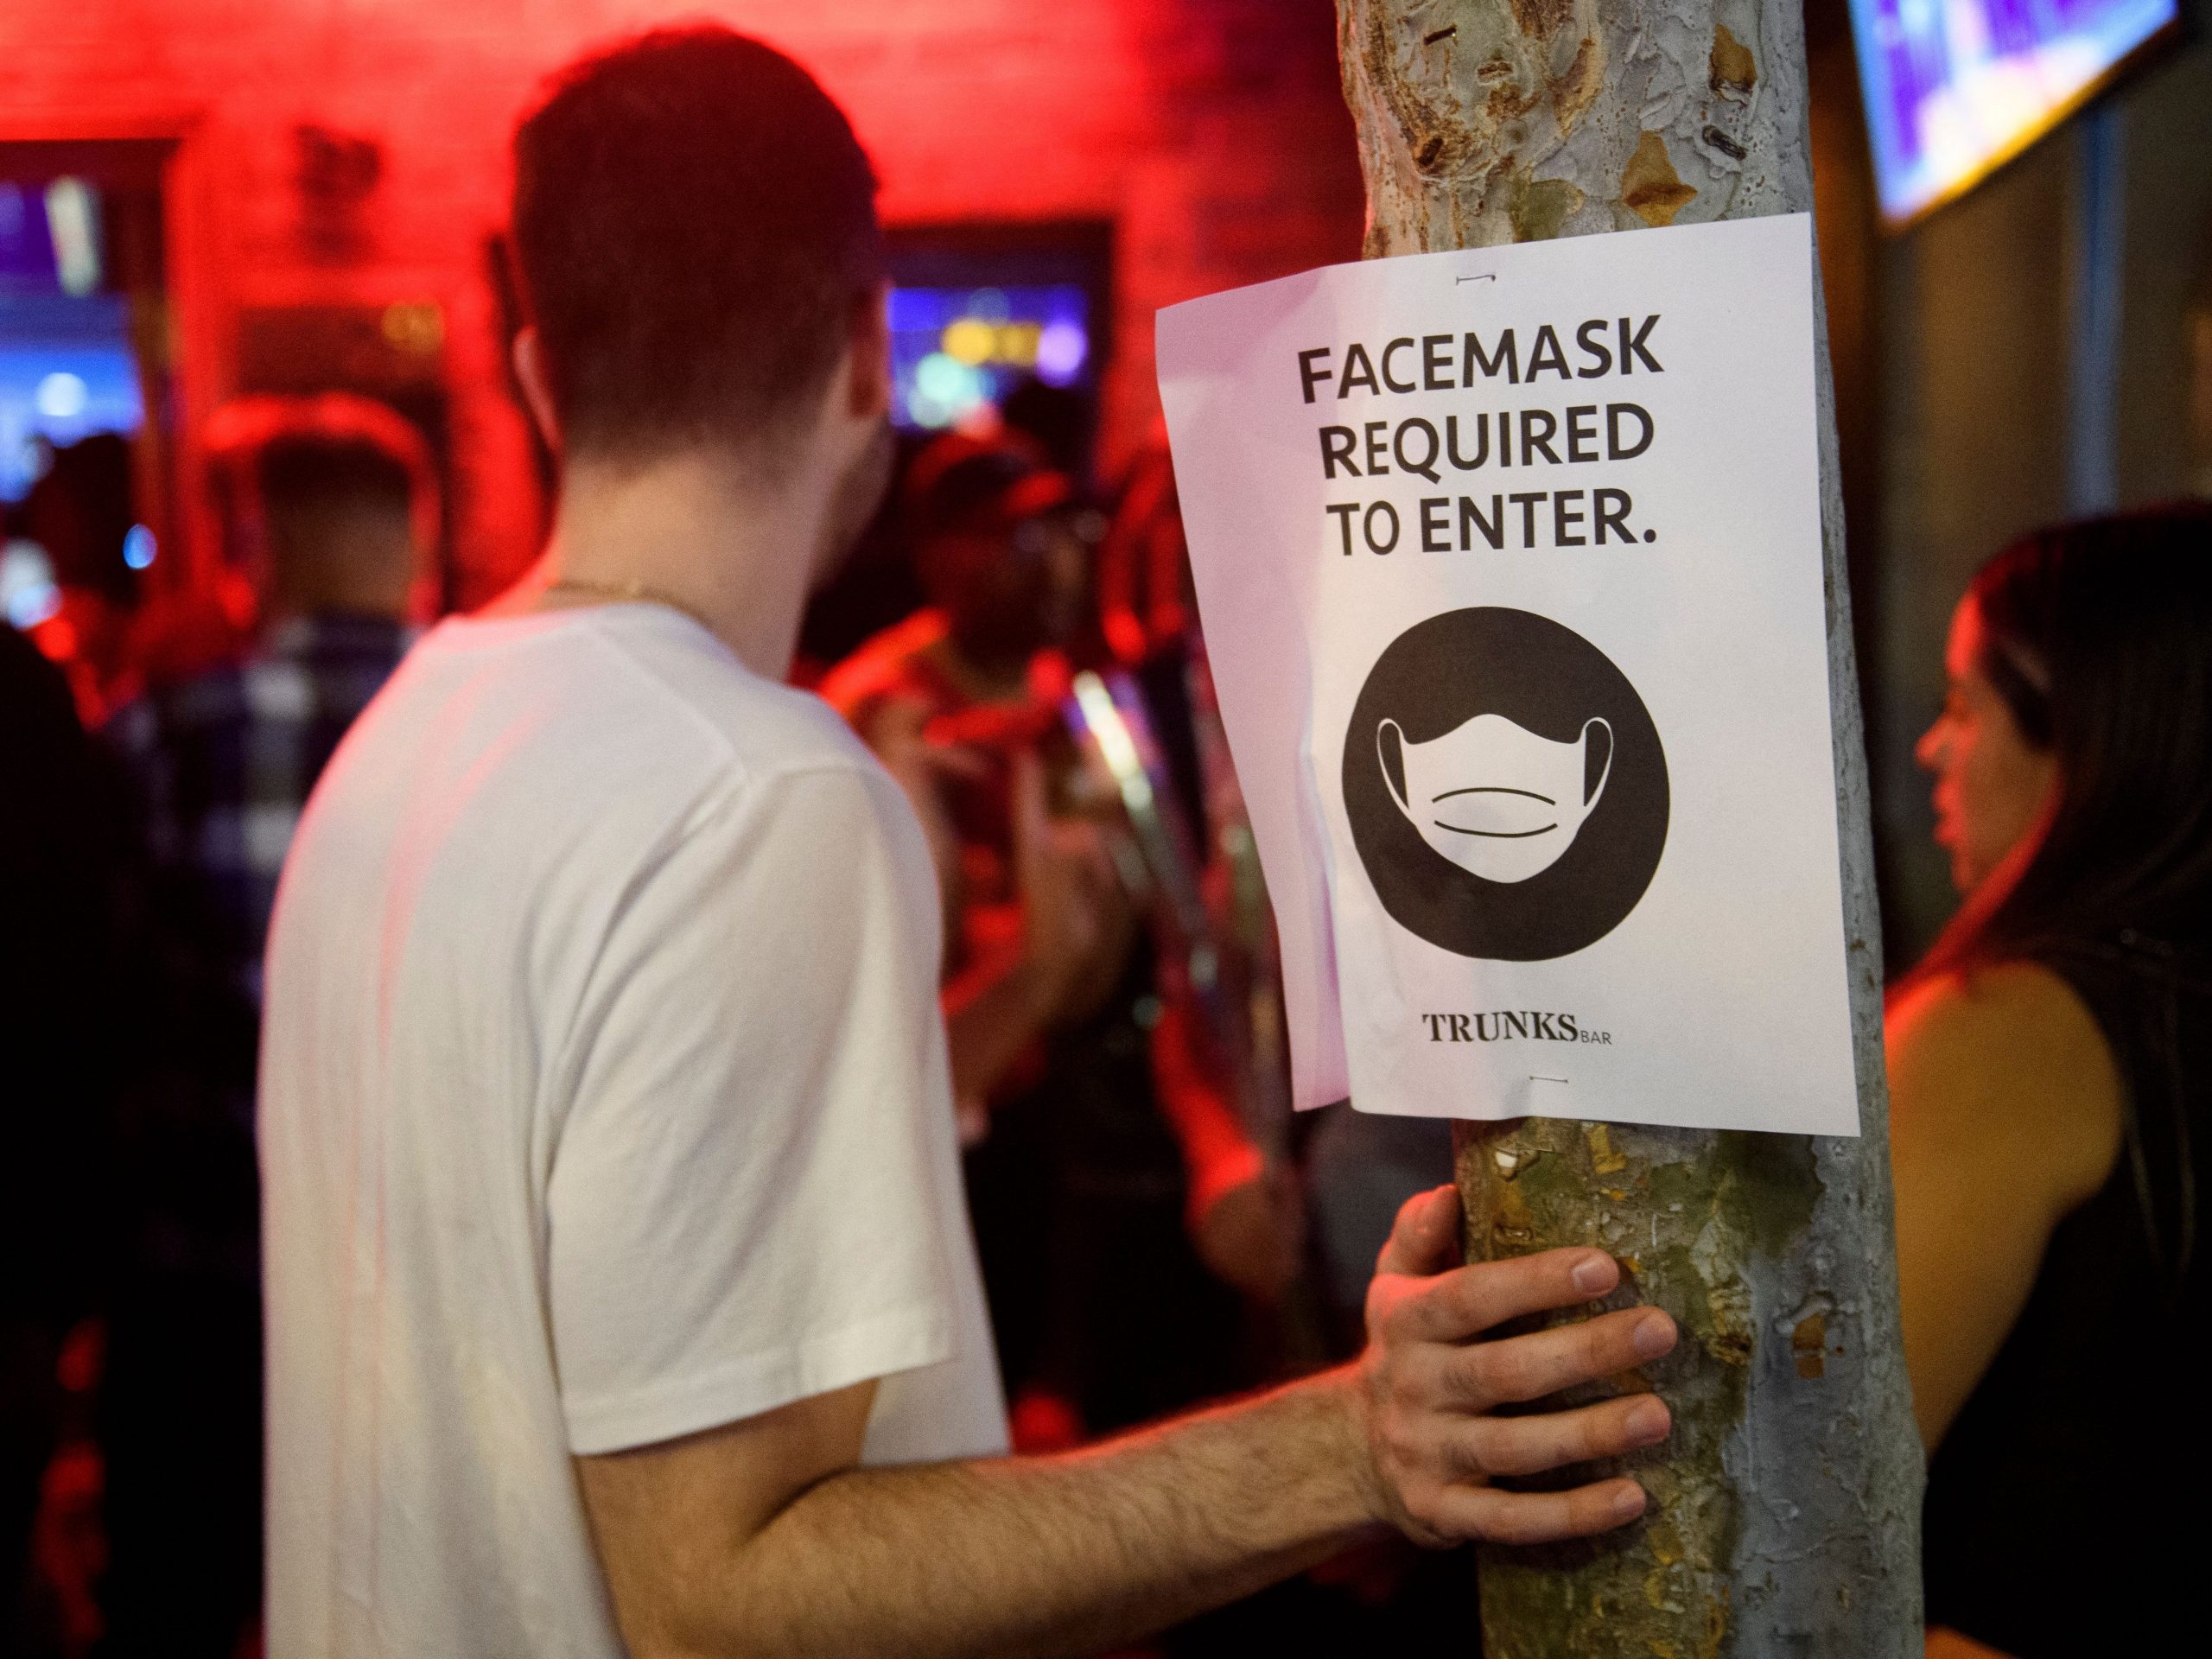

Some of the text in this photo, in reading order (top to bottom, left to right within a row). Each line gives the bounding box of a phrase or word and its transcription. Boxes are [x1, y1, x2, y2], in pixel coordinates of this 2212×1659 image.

[1298, 315, 1665, 404] FACEMASK
[1319, 403, 1654, 485] REQUIRED
[1325, 487, 1656, 556] TO ENTER.
[1422, 1011, 1612, 1045] TRUNKS BAR
